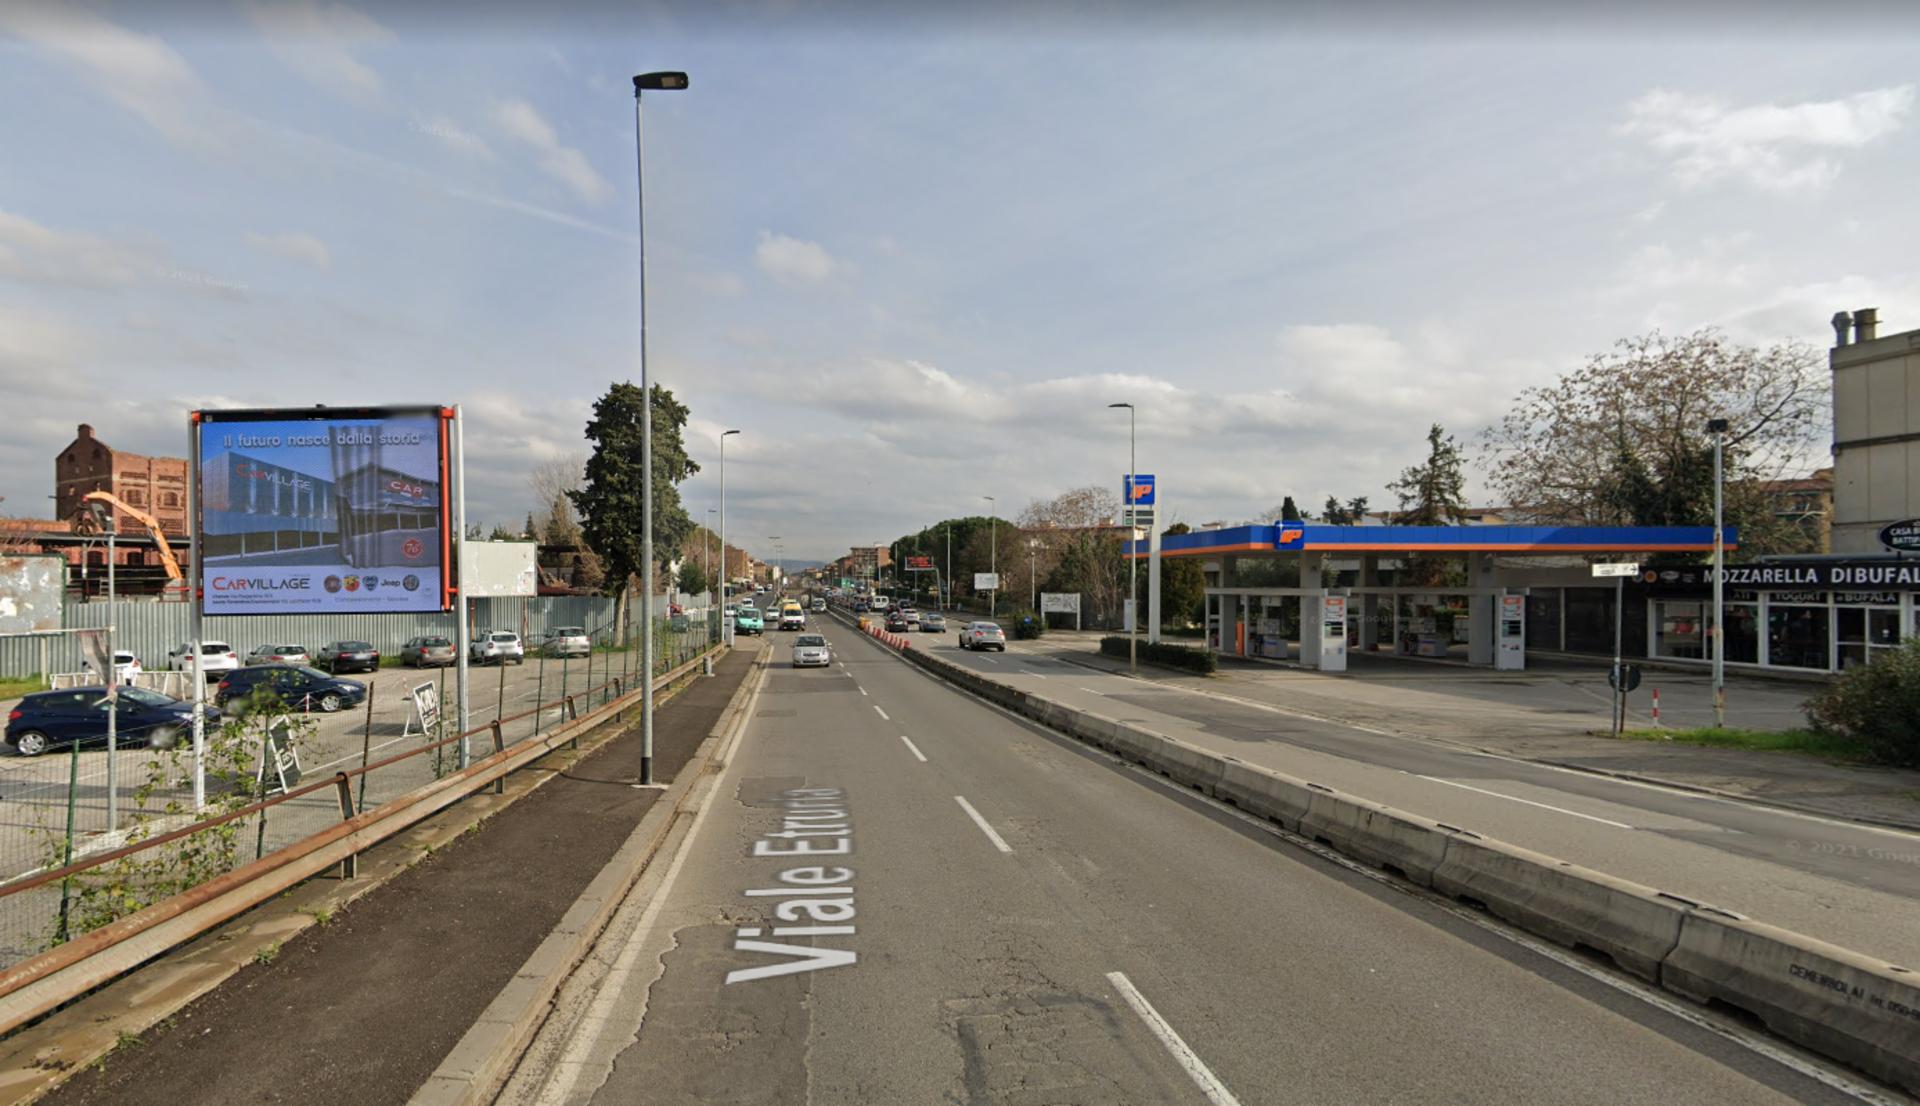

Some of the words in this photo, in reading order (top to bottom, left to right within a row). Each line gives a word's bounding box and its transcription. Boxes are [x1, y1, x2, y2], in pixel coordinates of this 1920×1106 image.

[238, 434, 281, 447] futuro
[287, 435, 331, 447] nasce
[337, 432, 373, 445] dalla
[379, 431, 421, 445] storia
[391, 481, 424, 496] CAR
[1703, 568, 1818, 583] MOZZARELLA
[381, 580, 401, 588] Jeep
